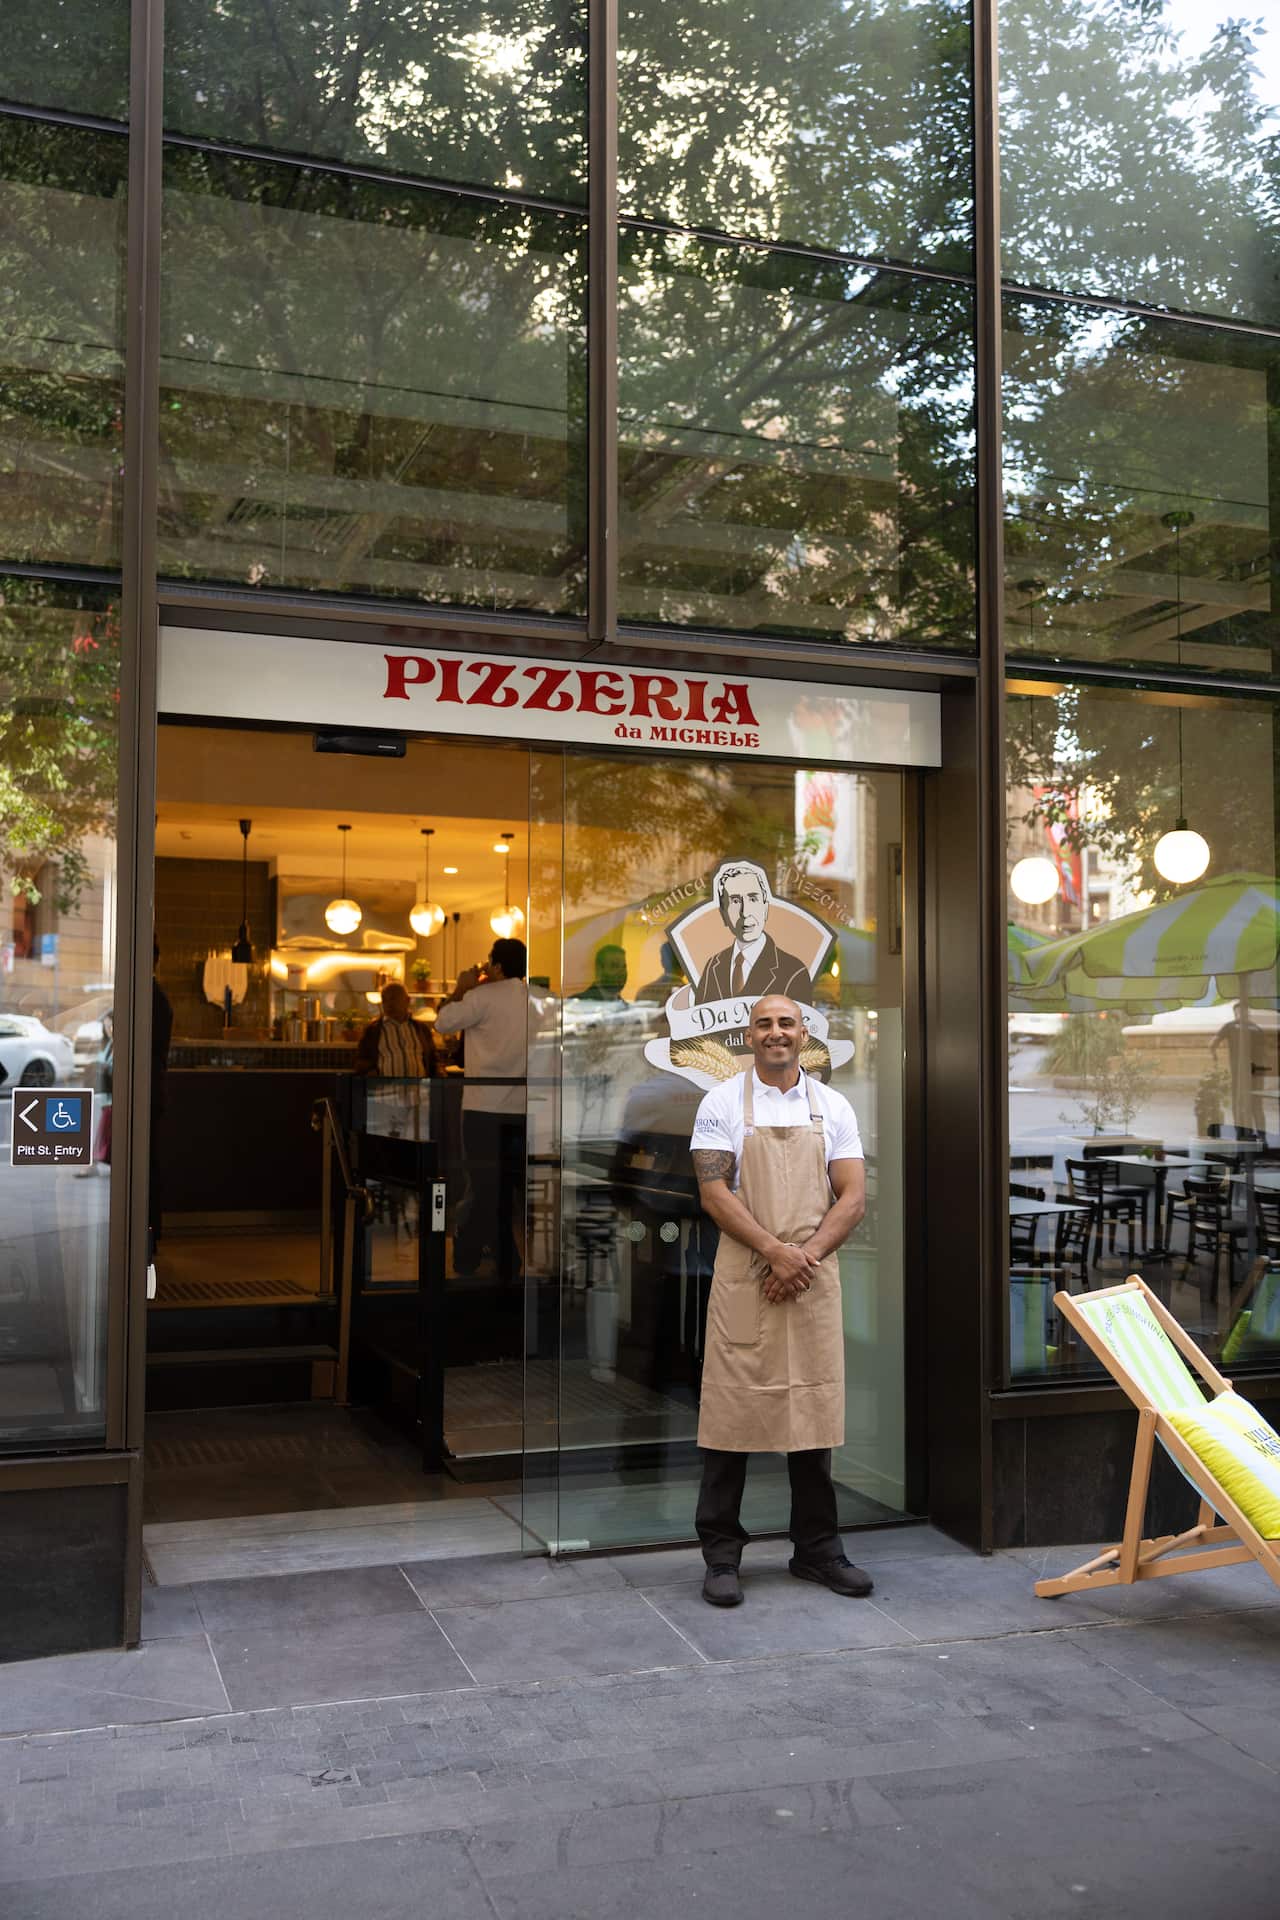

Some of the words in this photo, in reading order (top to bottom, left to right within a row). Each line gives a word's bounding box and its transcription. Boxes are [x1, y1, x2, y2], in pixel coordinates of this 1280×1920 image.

[383, 654, 760, 726] PIZZERIA
[614, 722, 642, 740] da
[691, 1007, 728, 1031] Da
[725, 1033, 744, 1047] dal
[17, 1145, 35, 1155] Pitt
[38, 1145, 51, 1155] St.
[55, 1145, 83, 1157] Entry
